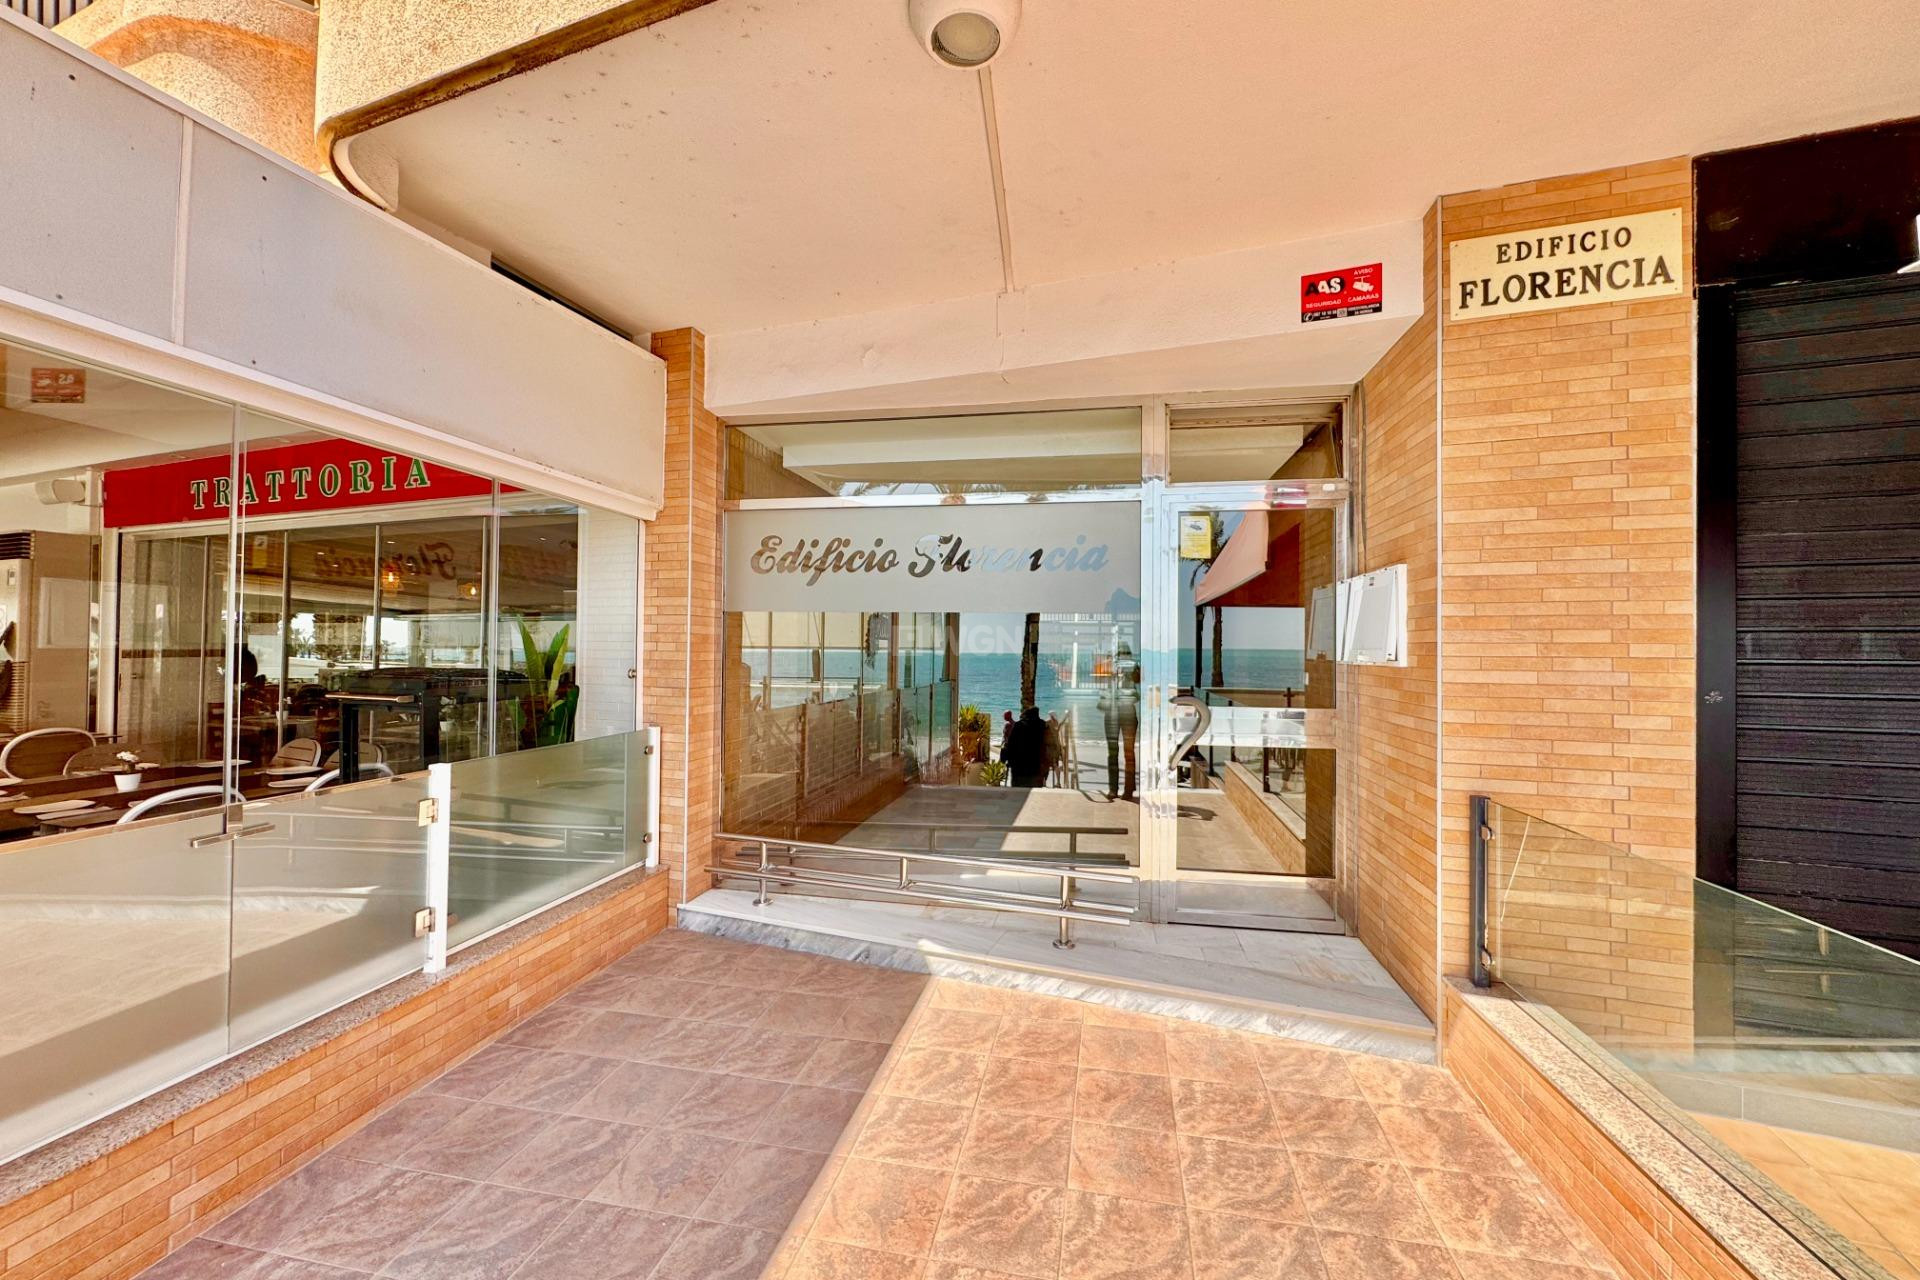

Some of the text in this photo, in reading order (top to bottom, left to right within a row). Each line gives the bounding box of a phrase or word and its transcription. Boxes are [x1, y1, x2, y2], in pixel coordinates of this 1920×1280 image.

[1496, 226, 1632, 264] EDIFICIO
[1353, 268, 1374, 276] AVISO
[1459, 255, 1675, 310] FLORENCIA
[1305, 299, 1342, 309] SEGURIDAD
[1347, 293, 1380, 303] CAMARAS
[190, 455, 431, 511] TRATTORIA
[750, 533, 1110, 587] Edificio Florencia
